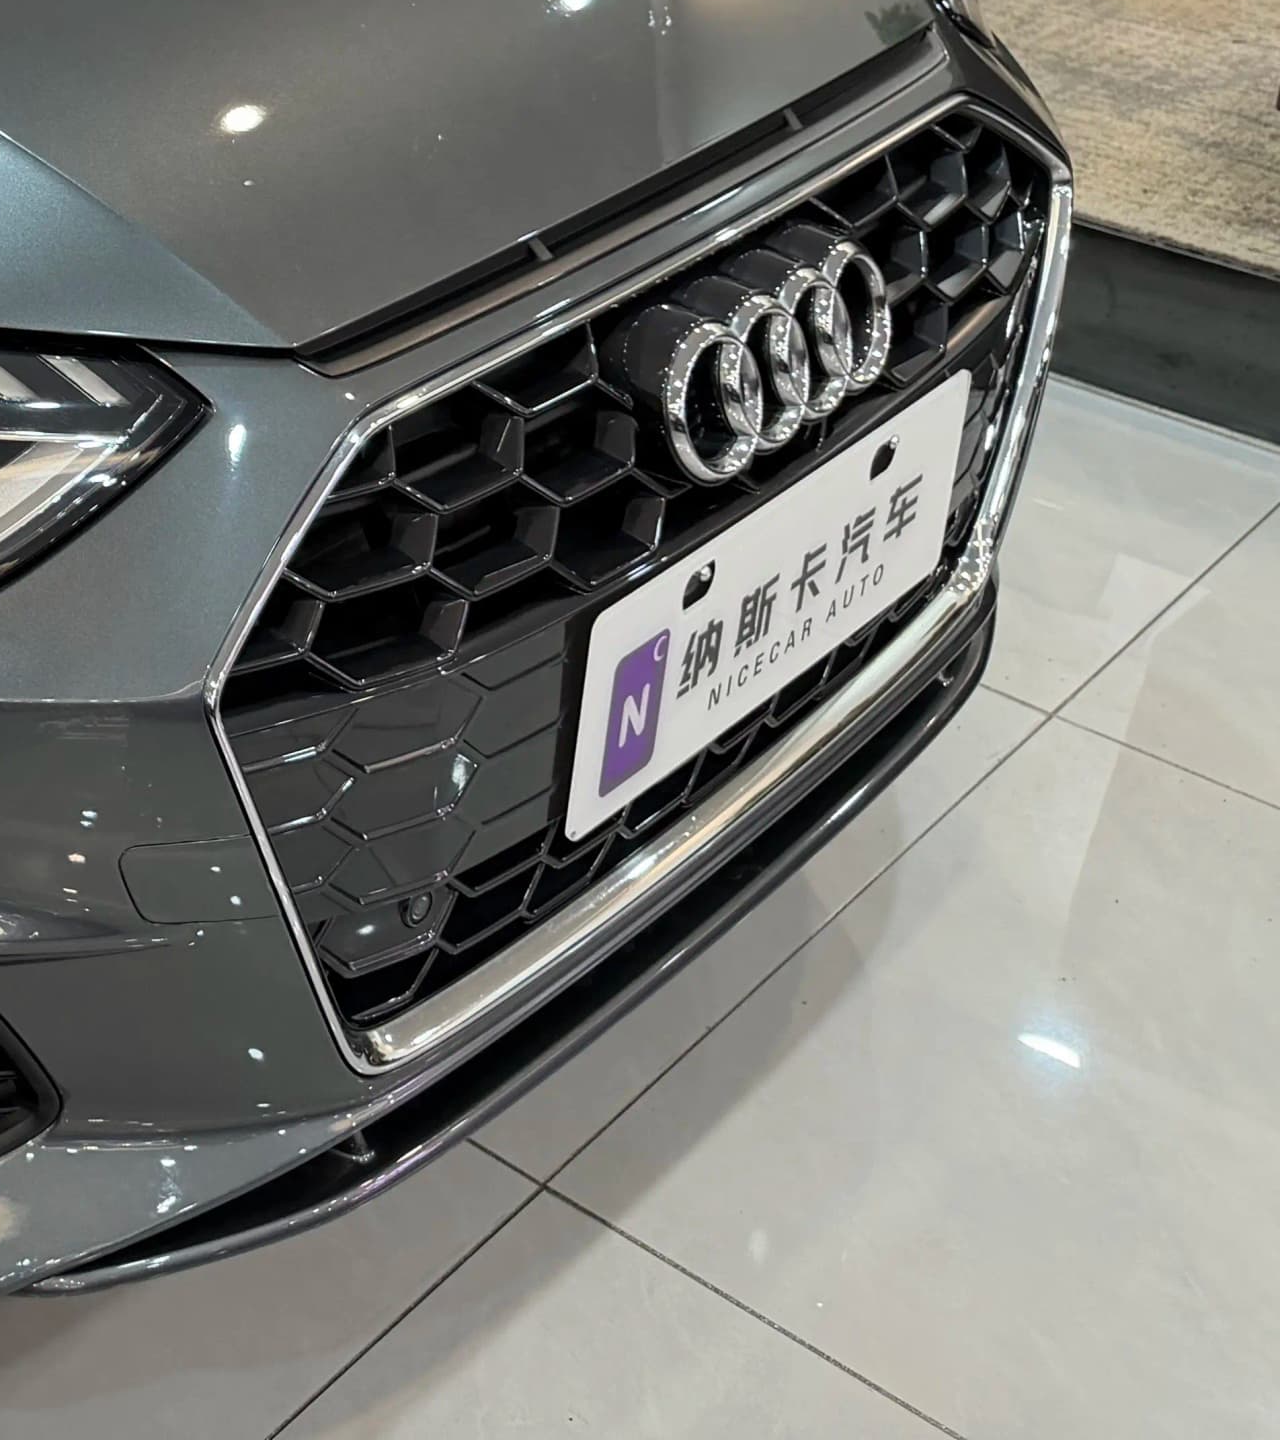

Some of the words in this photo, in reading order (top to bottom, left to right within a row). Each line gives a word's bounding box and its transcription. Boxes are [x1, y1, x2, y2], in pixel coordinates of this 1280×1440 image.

[676, 474, 924, 700] 纳斯卡汽车
[707, 618, 813, 711] NICECAR
[825, 563, 885, 623] AUTO
[618, 682, 651, 749] N
